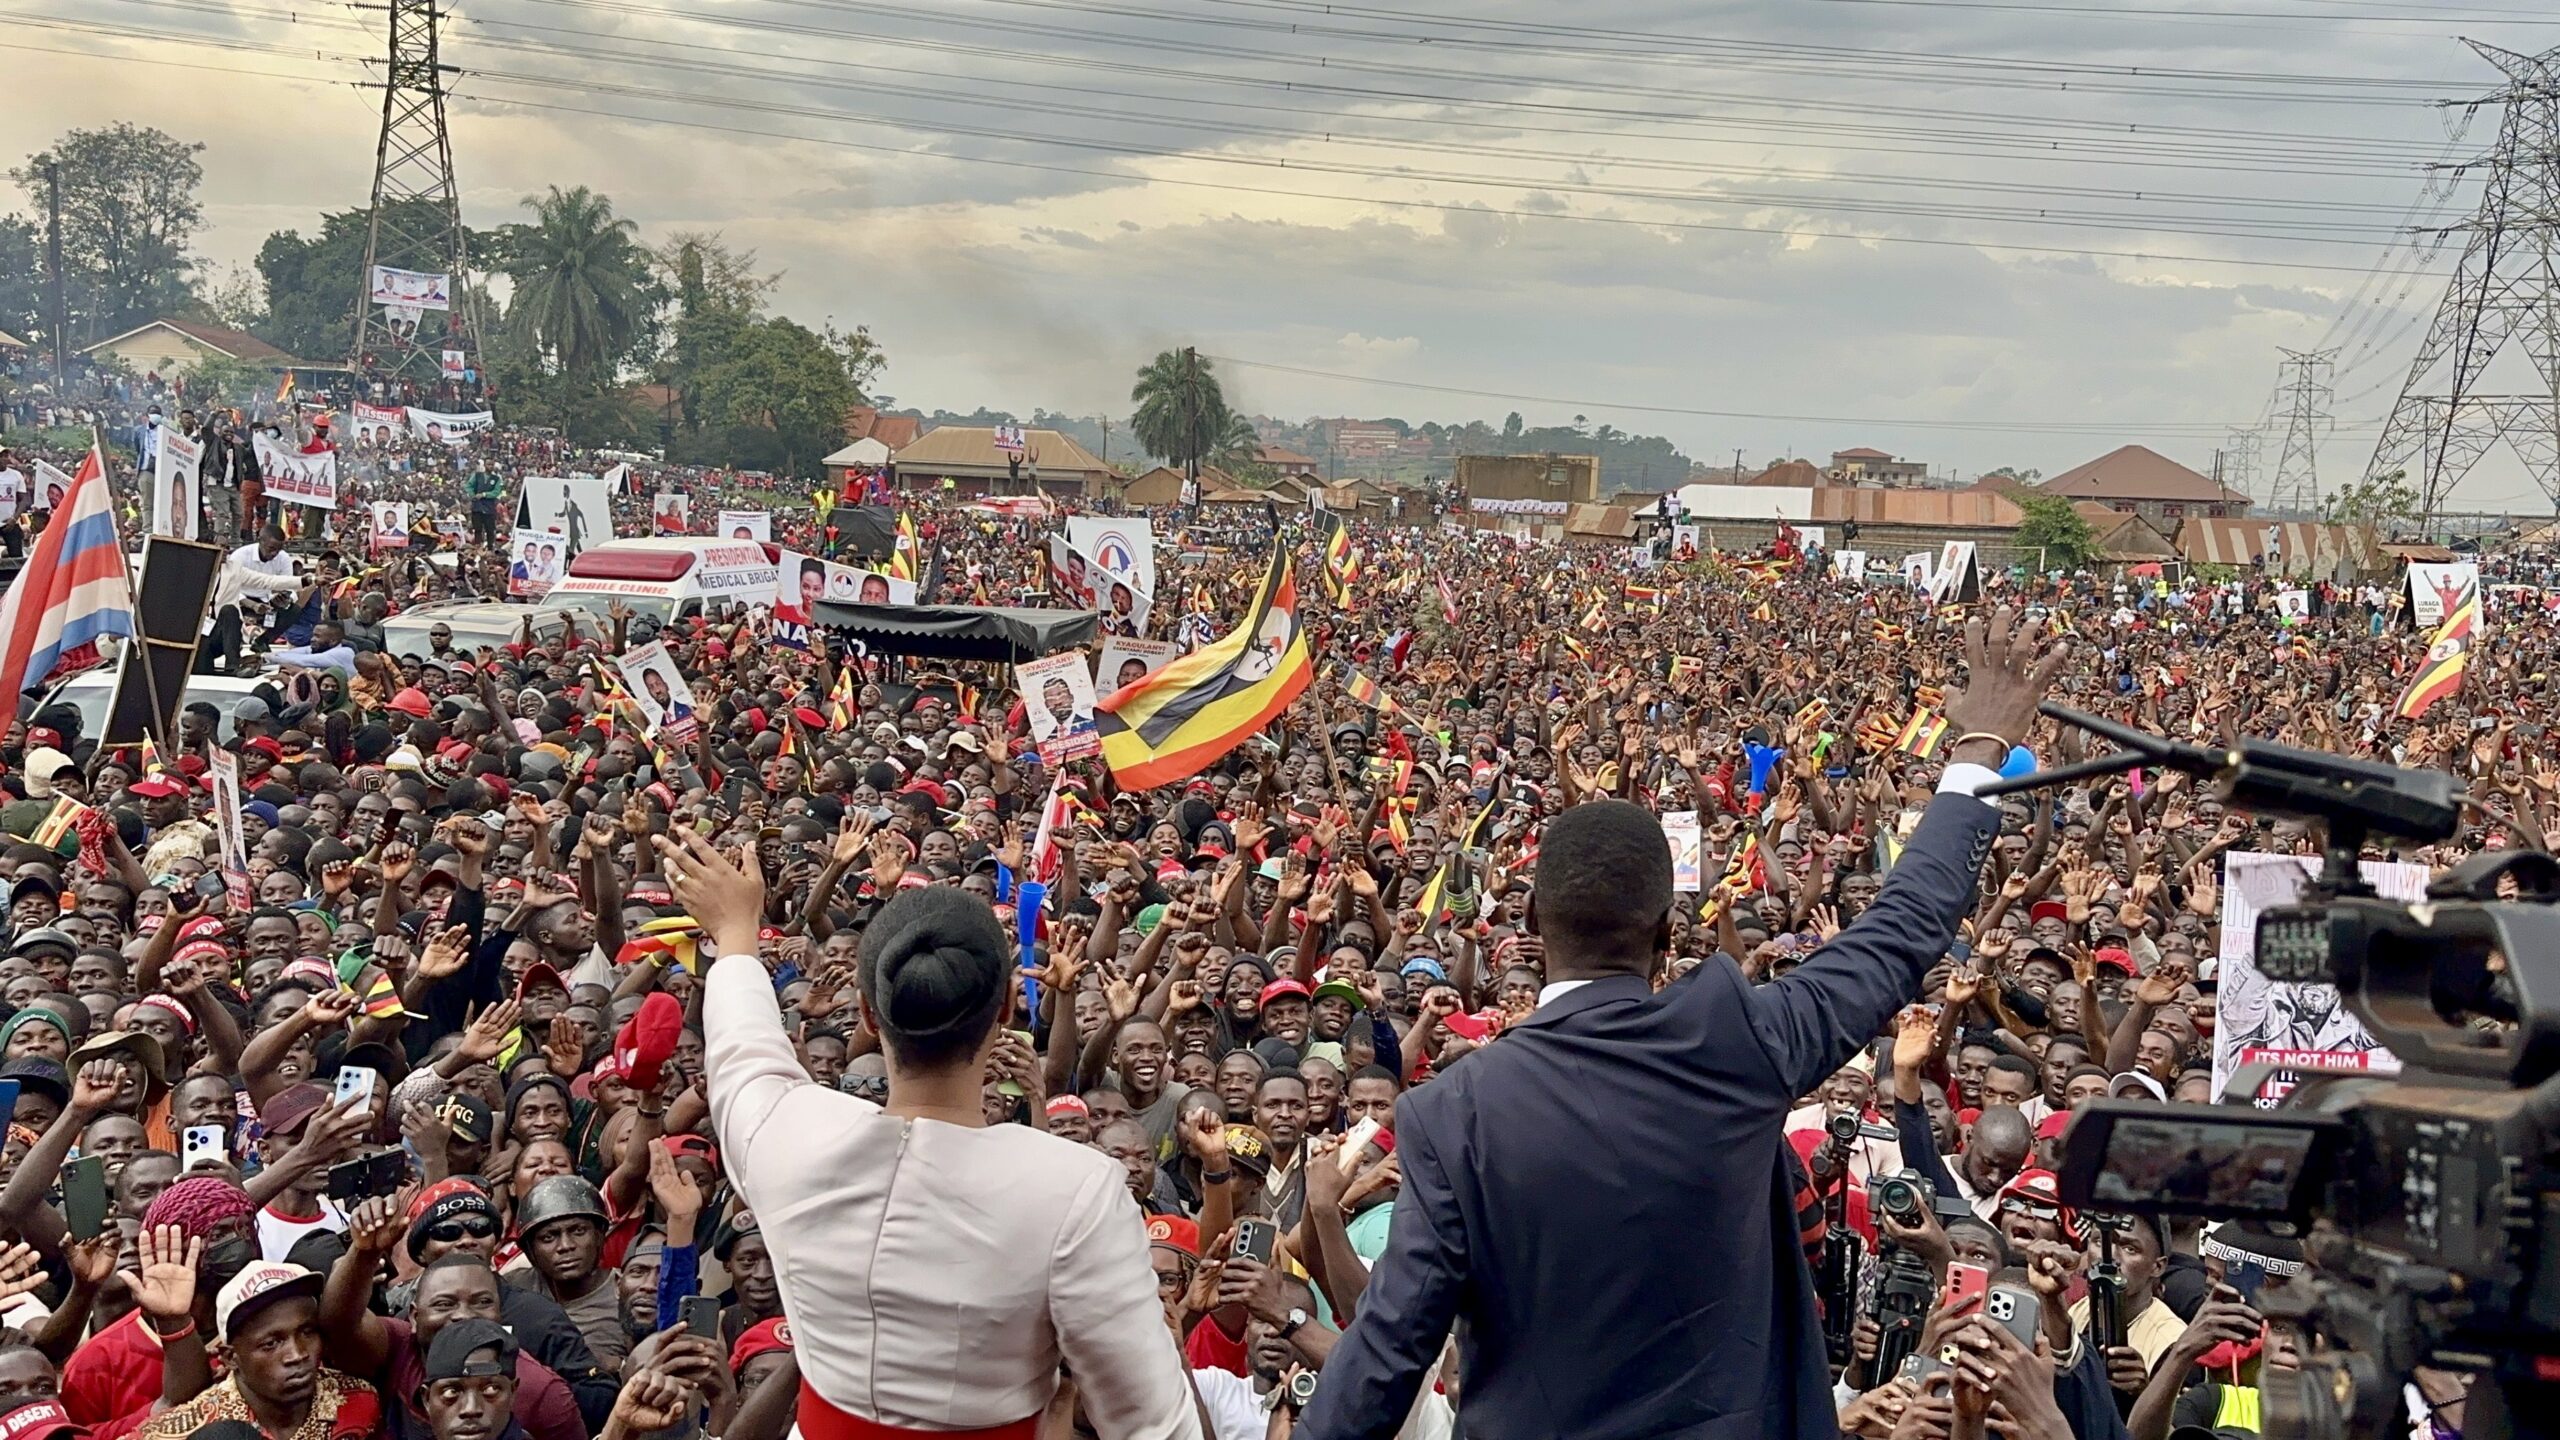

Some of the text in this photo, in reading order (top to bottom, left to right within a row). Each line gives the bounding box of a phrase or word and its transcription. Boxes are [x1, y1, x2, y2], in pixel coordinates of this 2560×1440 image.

[706, 547, 765, 568] PRESIDENTIAL
[563, 582, 617, 592] MOBILE
[619, 584, 669, 595] CLINIC
[701, 569, 779, 590] MEDICAL BRIGA
[1116, 640, 1166, 652] KYAGULANYI
[2255, 1051, 2359, 1068] ITS NOT HIM
[437, 1197, 485, 1217] BOSS
[7, 1405, 56, 1432] DESERT
